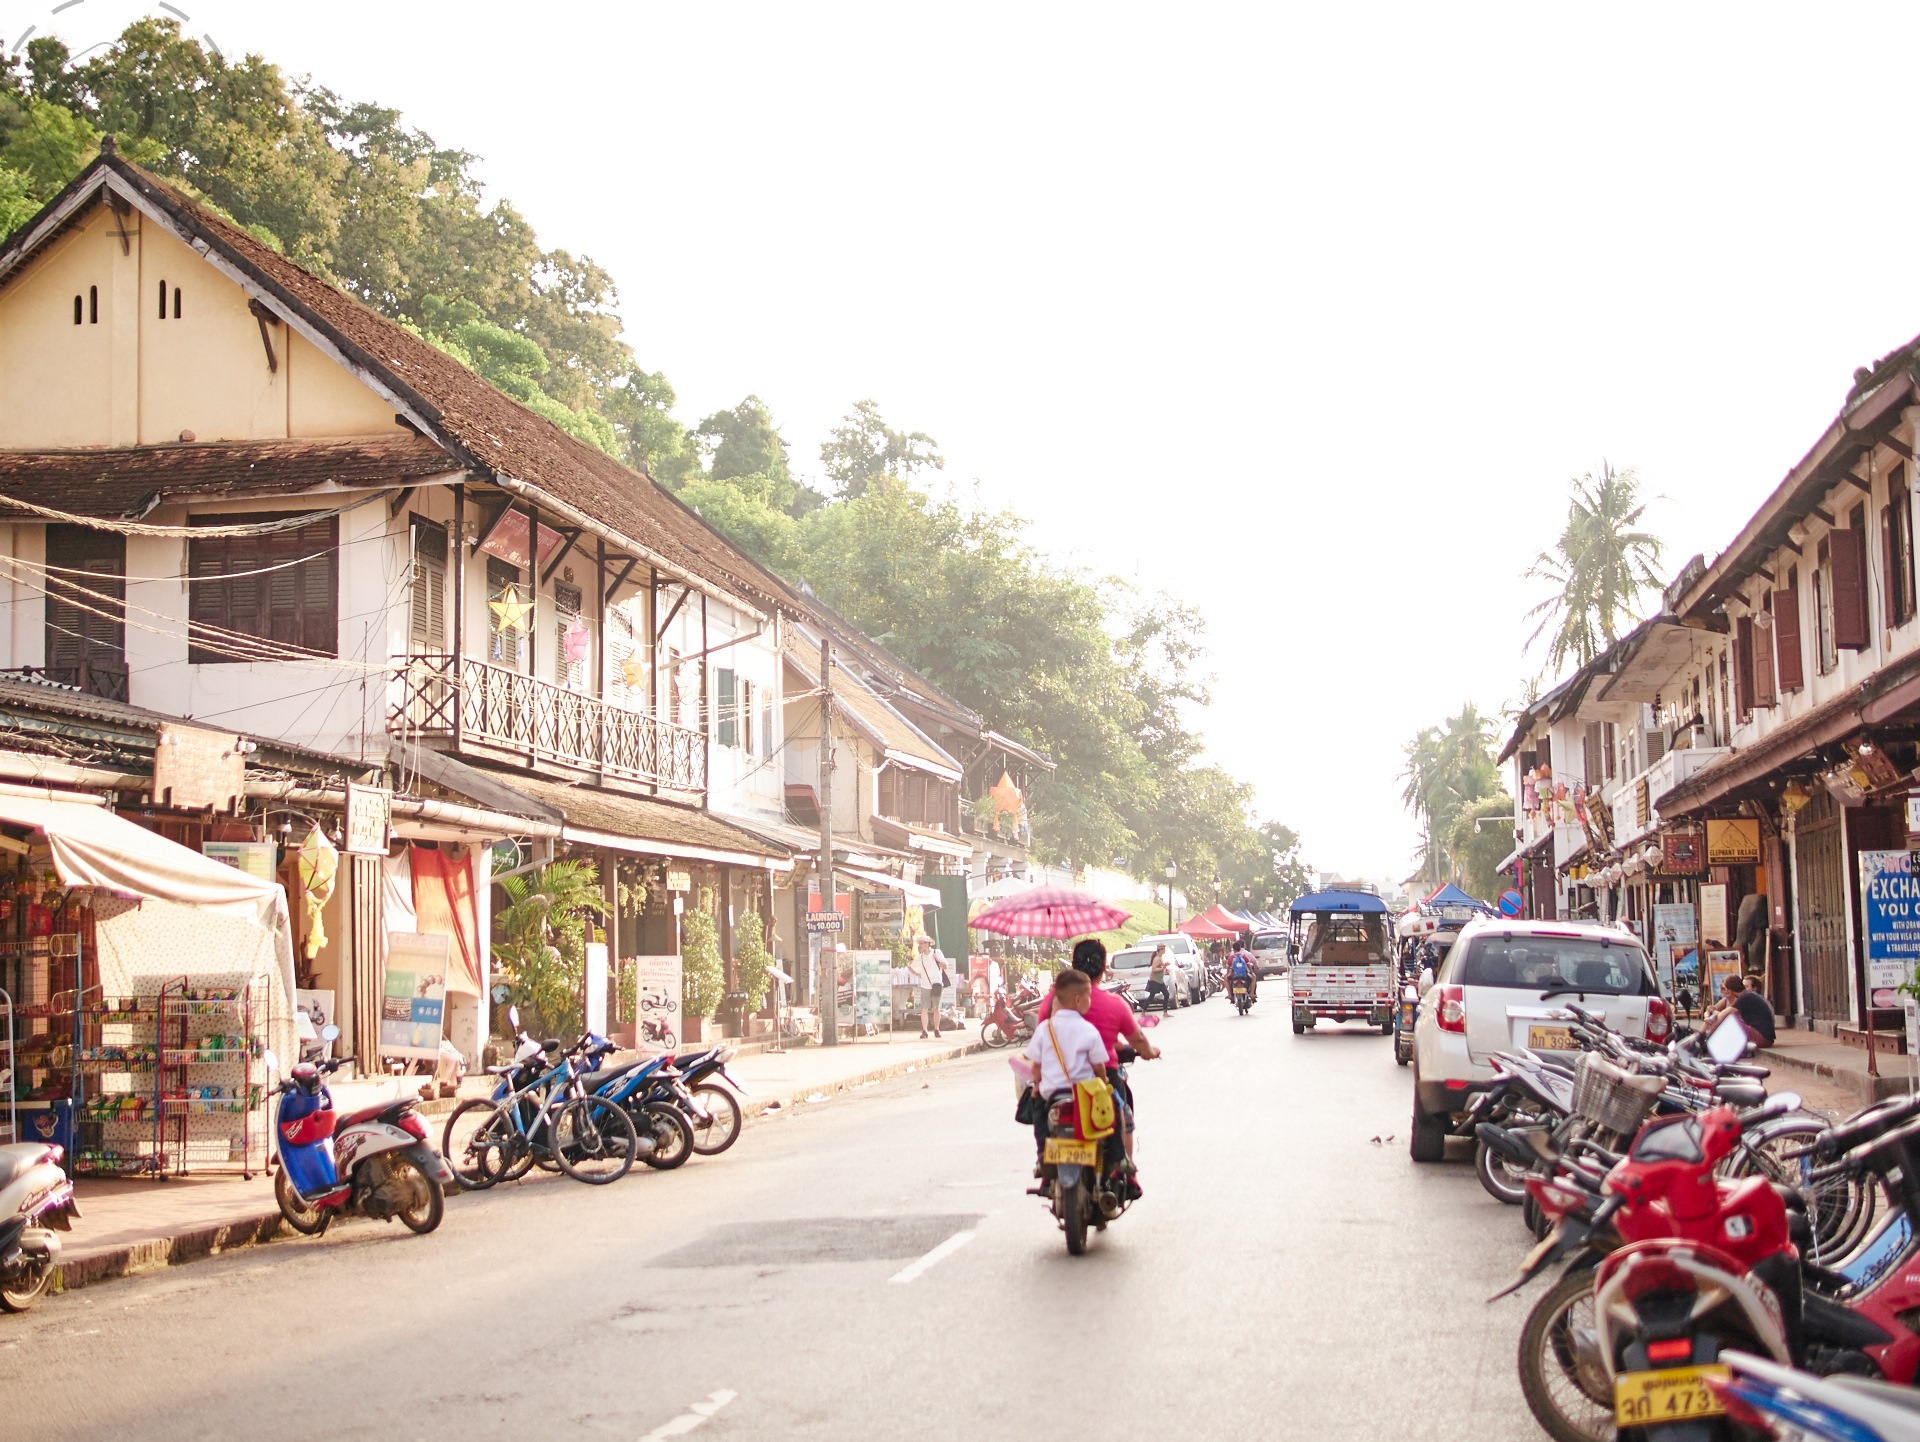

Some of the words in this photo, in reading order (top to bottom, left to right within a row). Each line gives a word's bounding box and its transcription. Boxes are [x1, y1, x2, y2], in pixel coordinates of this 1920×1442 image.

[1879, 903, 1908, 916] YOU
[806, 912, 843, 921] LAUNDRY
[1892, 921, 1905, 929] WITH
[1872, 933, 1885, 941] WITH
[1886, 933, 1899, 941] YOUR
[1900, 932, 1912, 940] VISA
[1665, 1390, 1722, 1415] 473
